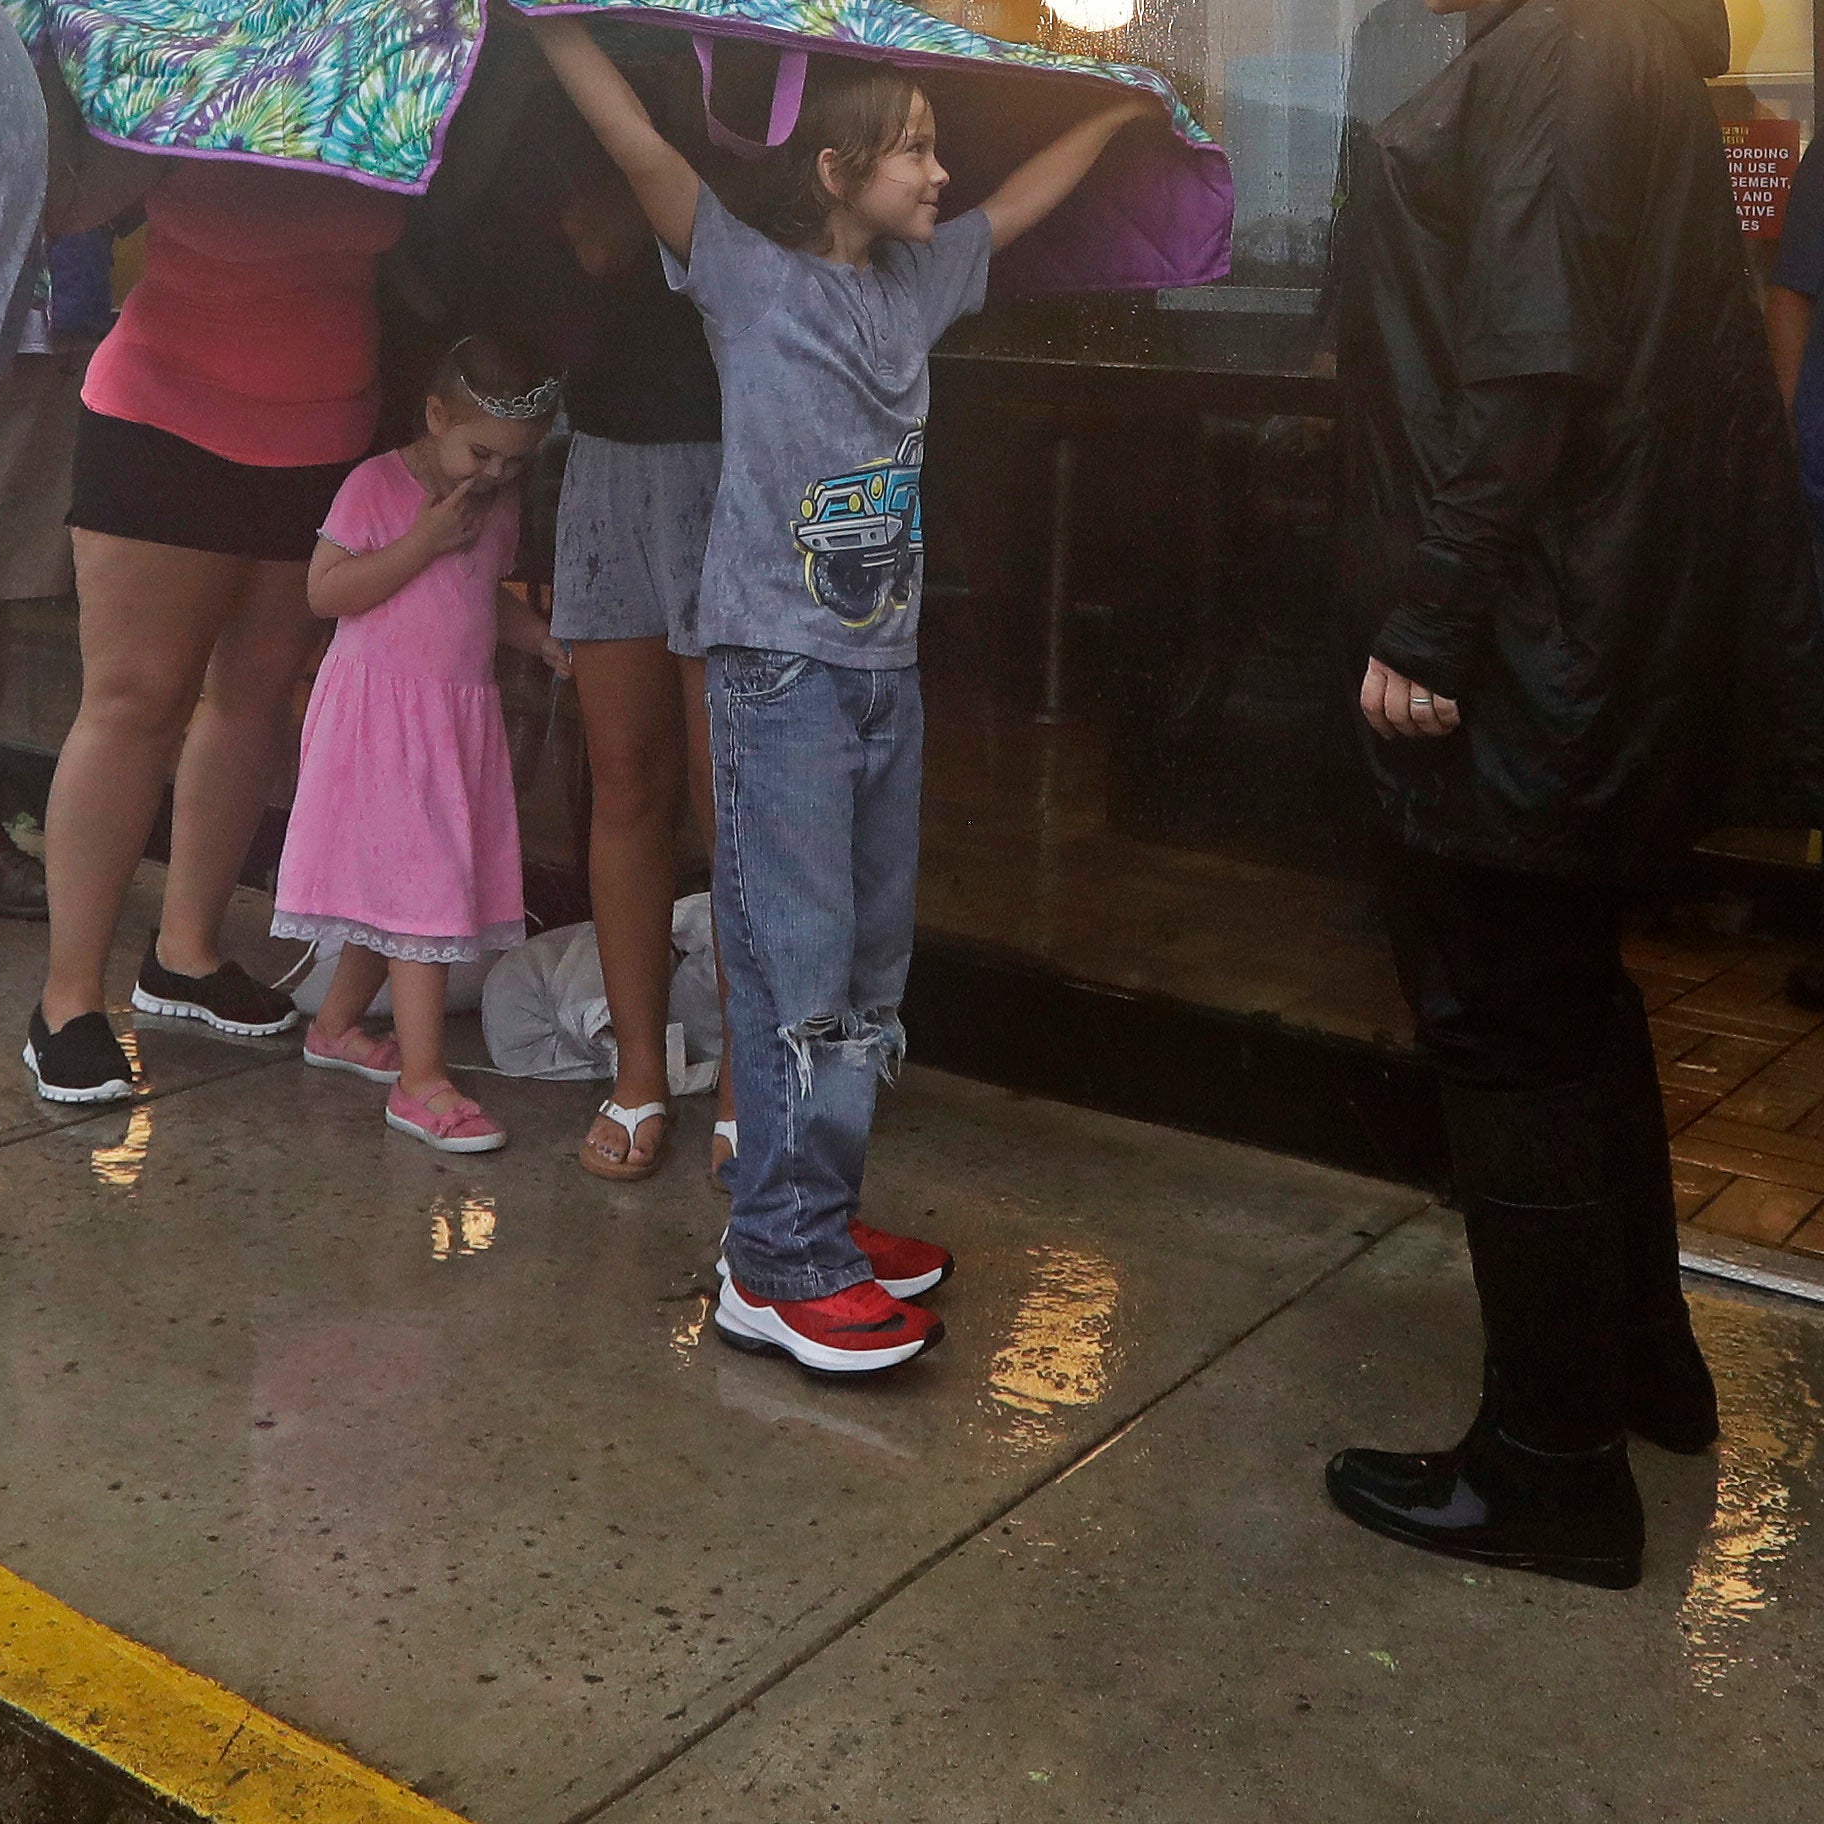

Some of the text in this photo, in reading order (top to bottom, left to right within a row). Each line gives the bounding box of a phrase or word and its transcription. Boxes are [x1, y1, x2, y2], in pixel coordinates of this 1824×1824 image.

[1729, 162, 1776, 173] IN USE
[1743, 191, 1772, 202] AND
